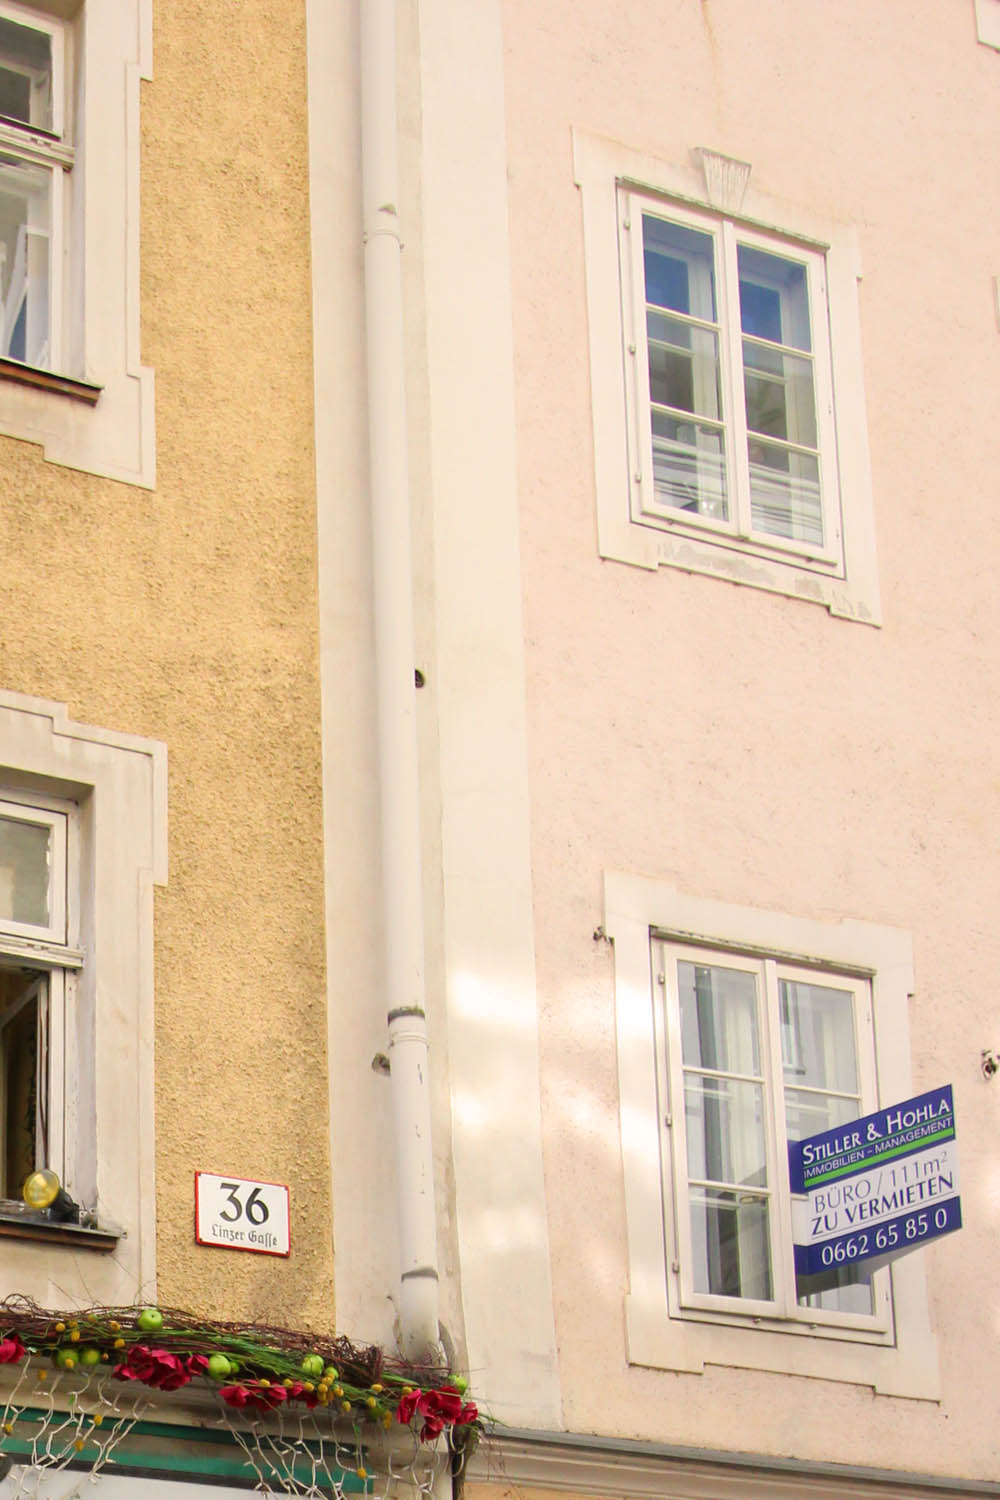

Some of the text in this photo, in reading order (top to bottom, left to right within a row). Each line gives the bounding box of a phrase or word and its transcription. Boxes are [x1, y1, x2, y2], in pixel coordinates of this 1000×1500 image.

[802, 1099, 950, 1165] STILLER & HOHLA
[803, 1150, 865, 1179] IMMOBILIEN
[875, 1117, 953, 1154] MANAGEMENT
[219, 1182, 270, 1226] 36
[811, 1171, 953, 1236] ZU VERMIETEN
[814, 1179, 871, 1213] BÜRO
[211, 1223, 245, 1242] Linzer
[821, 1207, 947, 1266] 0662 65 85 0
